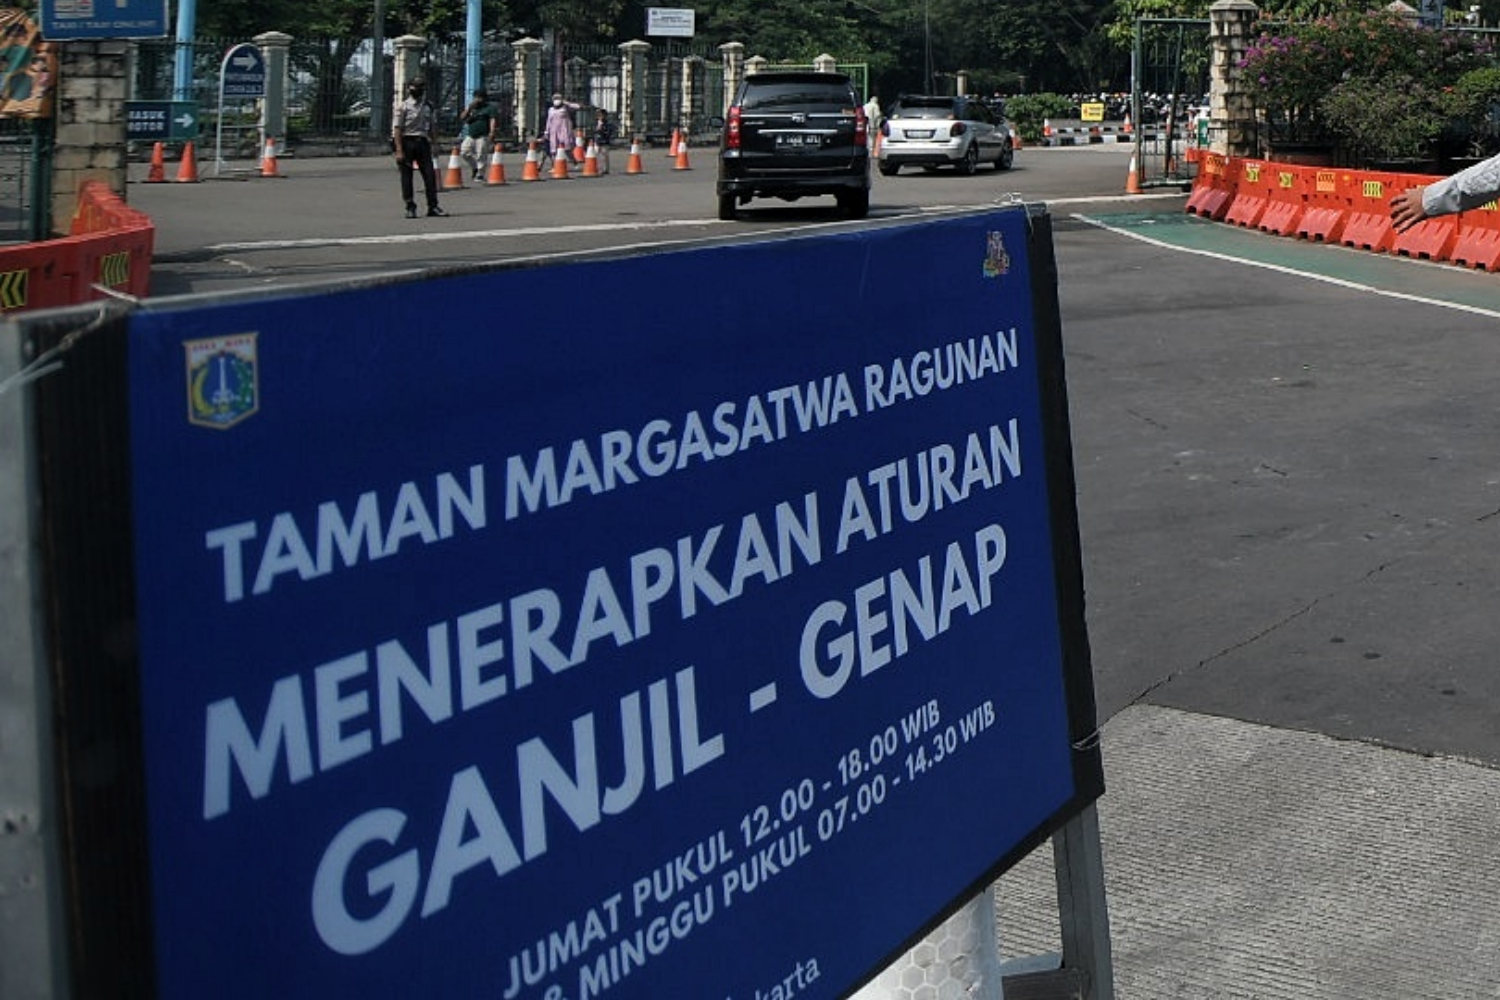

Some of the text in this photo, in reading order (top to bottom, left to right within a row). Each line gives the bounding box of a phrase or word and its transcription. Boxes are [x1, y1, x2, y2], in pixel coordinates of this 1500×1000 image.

[206, 327, 1018, 601] TAMAN MARGASATWA RAGUNAN
[204, 418, 1021, 818] MENERAPKAN ATURAN
[312, 523, 1007, 954] GANJIL - GENAP
[504, 699, 940, 999] JUMAT PUKUL 12.00 - 18.00 WIB
[580, 700, 995, 1000] MINGGU PUKUL 07.00 - 14.30 WIB
